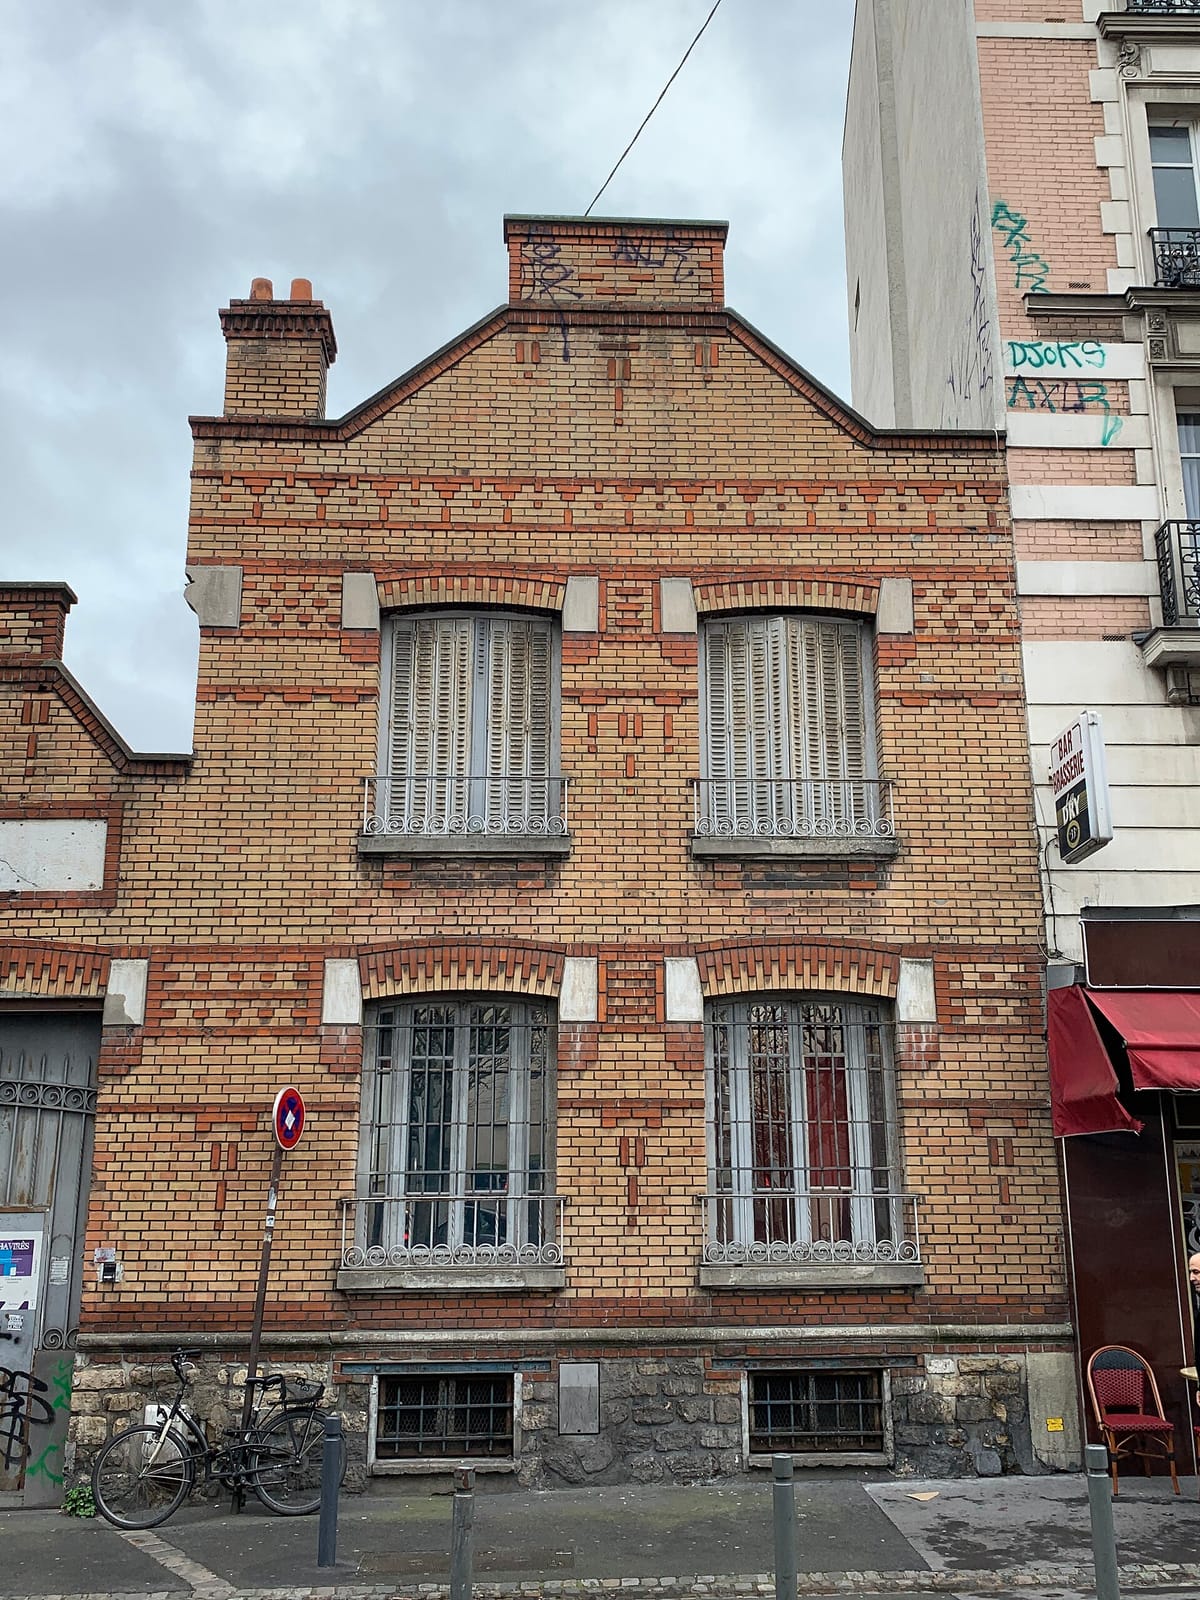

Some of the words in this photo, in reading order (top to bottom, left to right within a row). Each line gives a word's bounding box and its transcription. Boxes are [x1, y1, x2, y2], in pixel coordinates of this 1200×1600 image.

[1058, 729, 1073, 761] BAR
[1052, 749, 1085, 796] BRASSERIE
[1062, 795, 1080, 826] DRY
